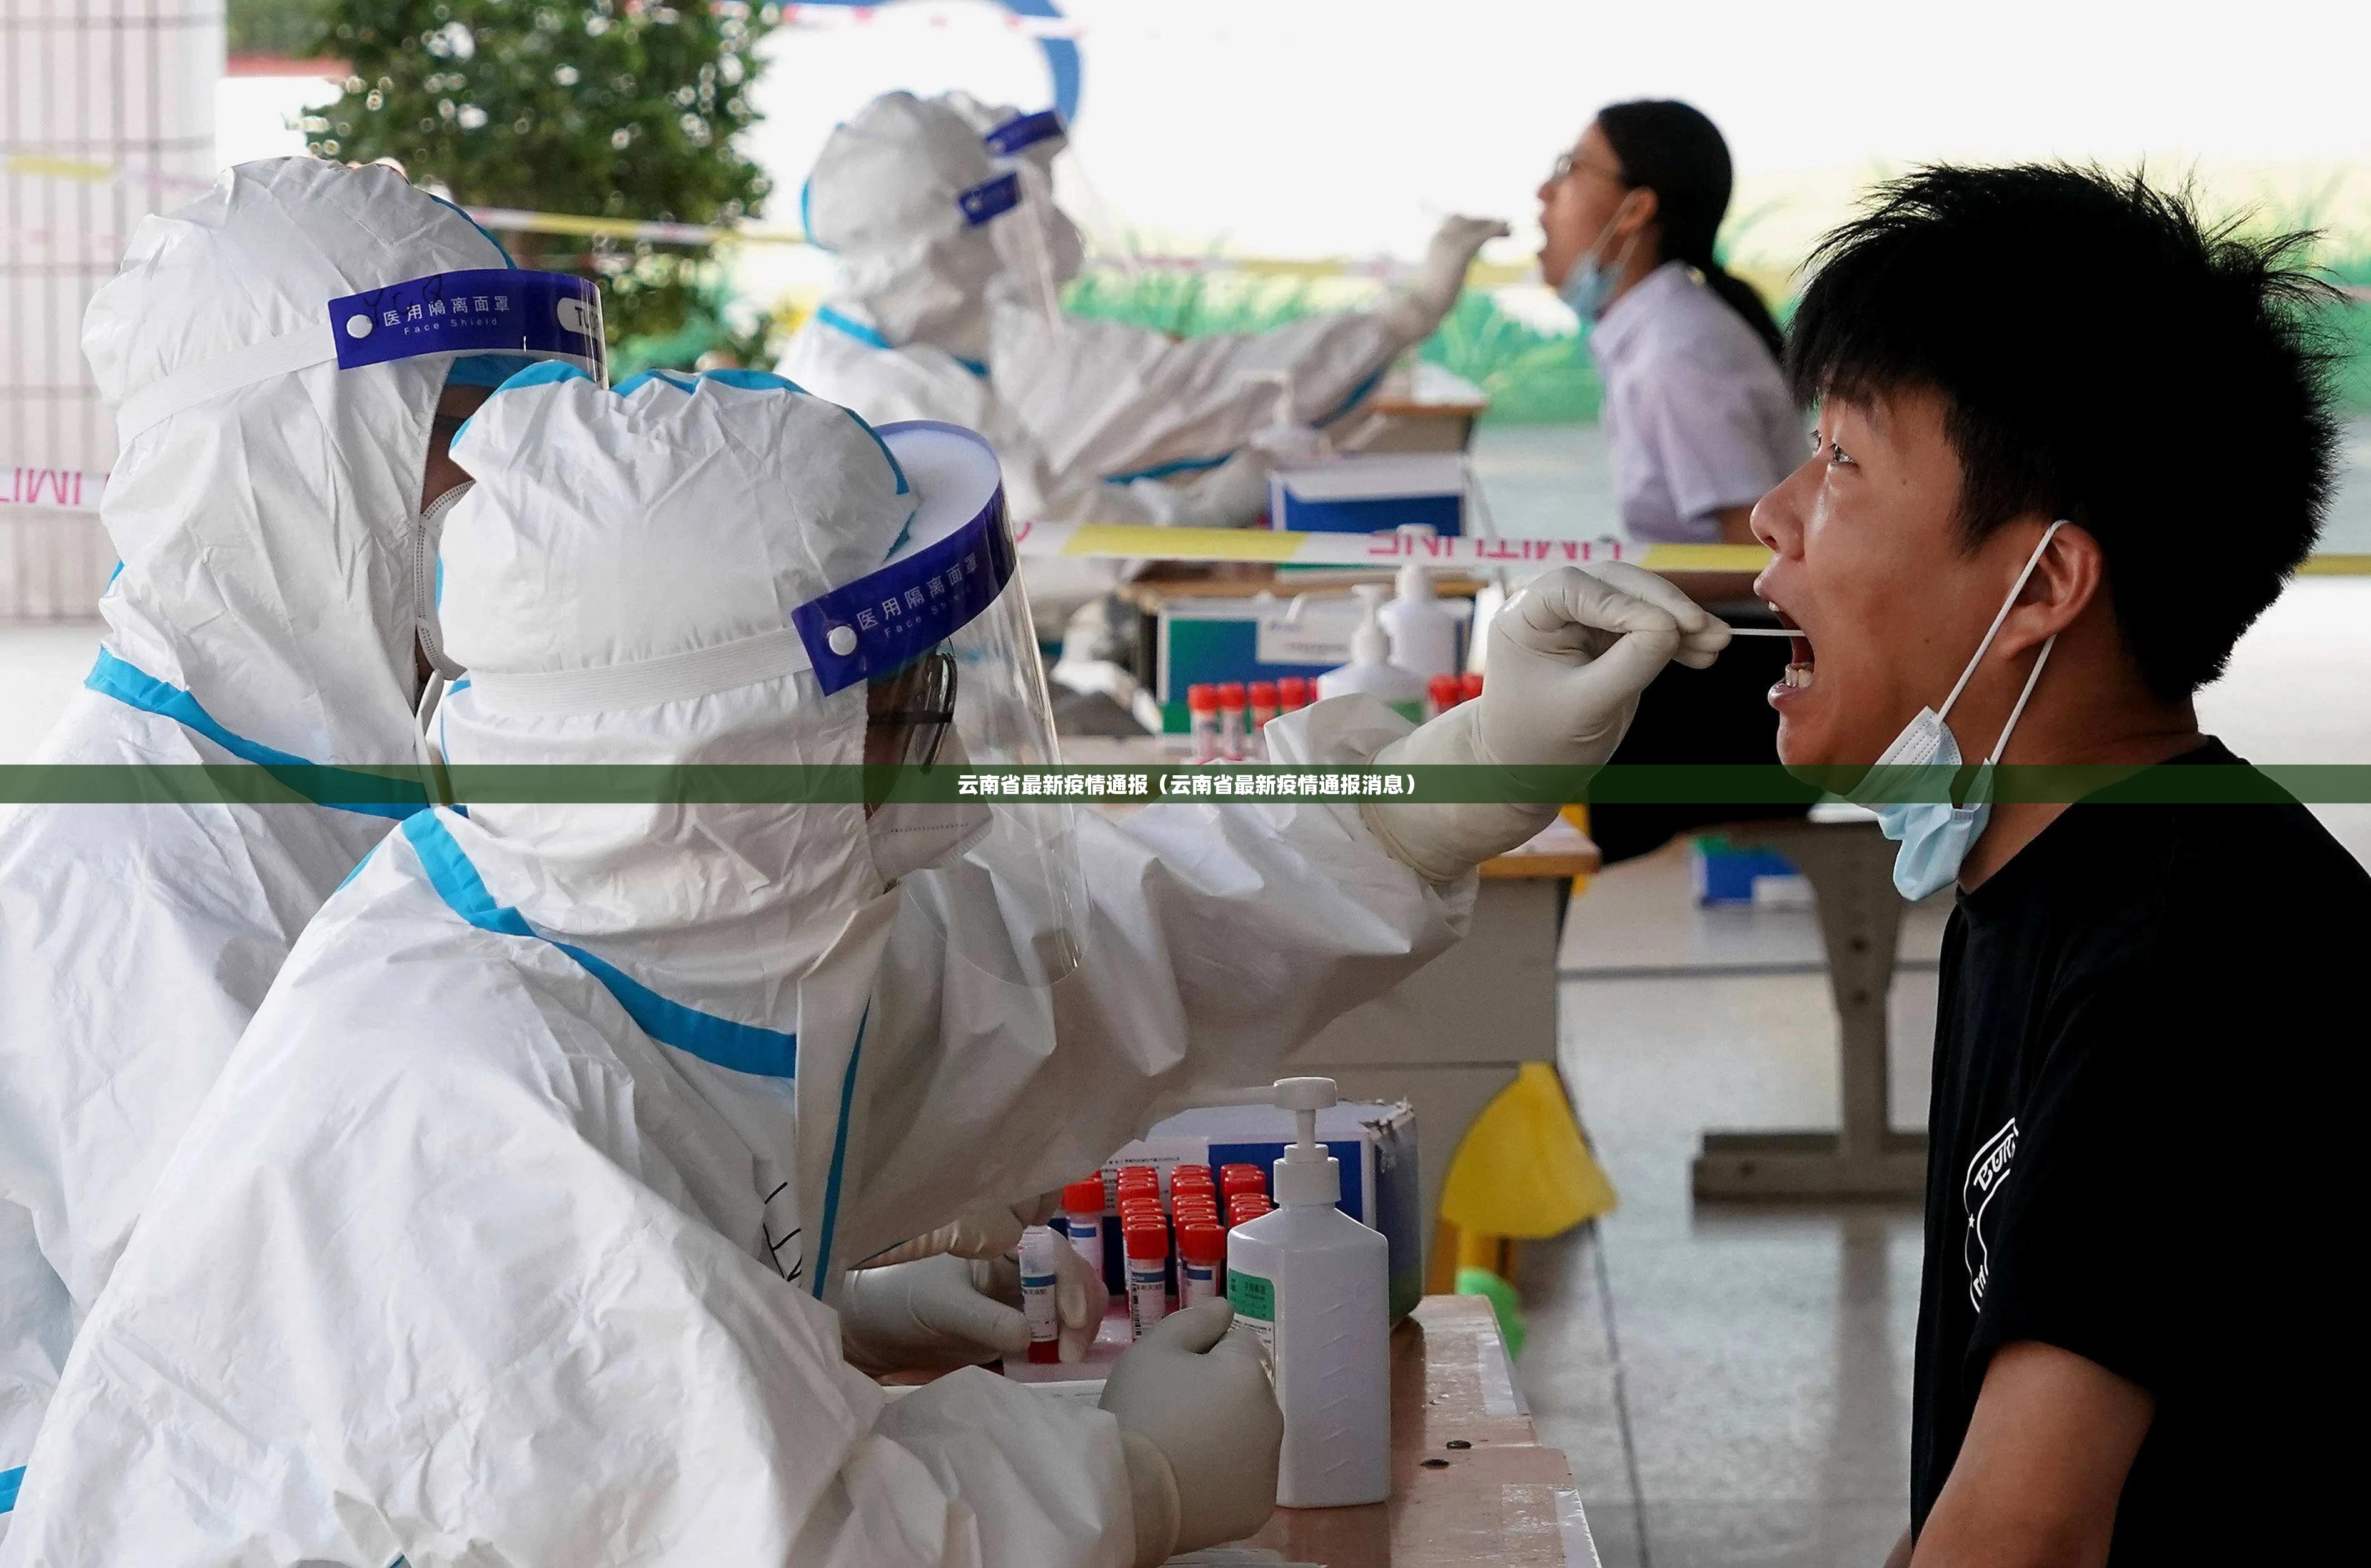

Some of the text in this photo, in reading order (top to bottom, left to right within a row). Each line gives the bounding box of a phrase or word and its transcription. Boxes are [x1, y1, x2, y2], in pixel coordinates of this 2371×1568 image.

[383, 295, 510, 327] 医用隔离面罩
[403, 317, 498, 335] Face Shield
[857, 552, 979, 631] 医用隔离面罩
[884, 615, 922, 638] Face
